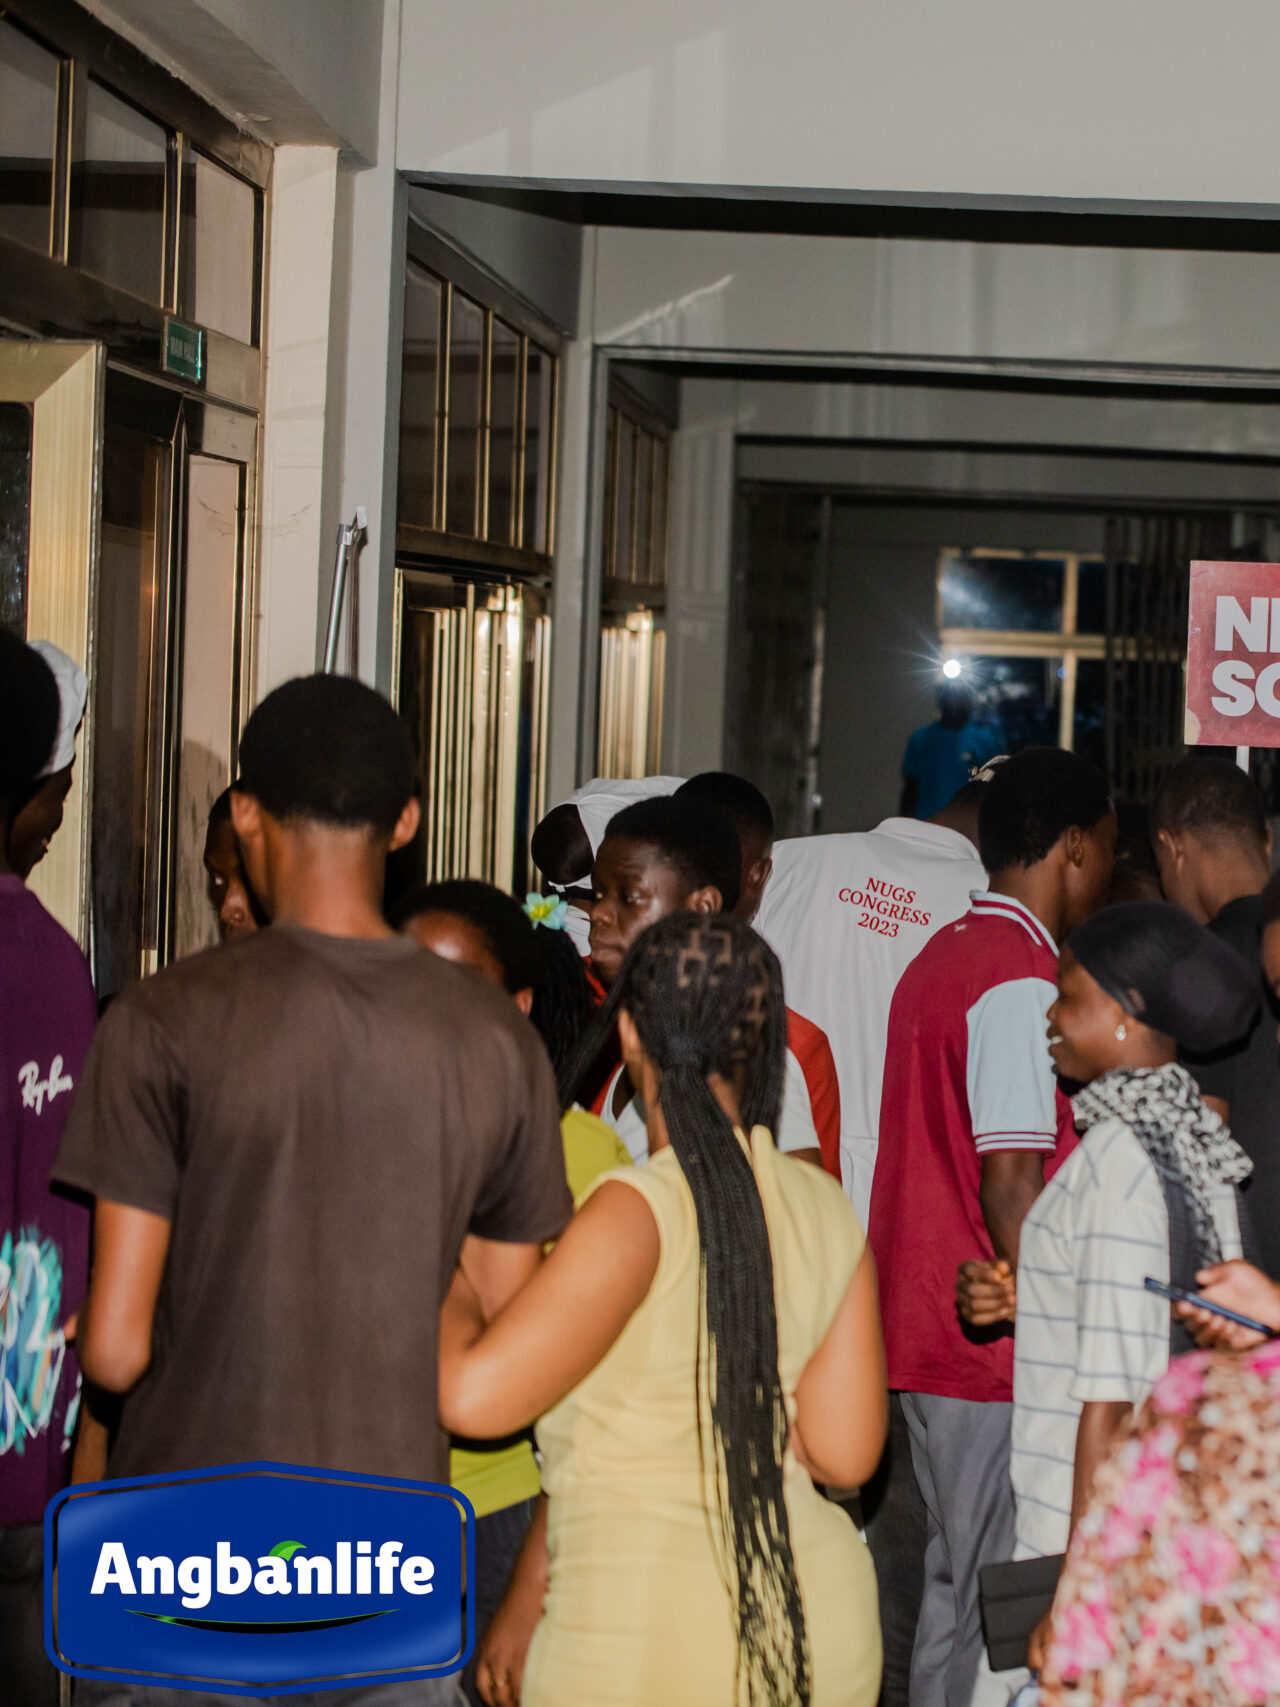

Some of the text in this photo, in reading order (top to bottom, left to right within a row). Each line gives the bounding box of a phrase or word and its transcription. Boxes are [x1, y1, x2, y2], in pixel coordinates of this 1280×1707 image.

[865, 876, 917, 905] NUGS
[838, 887, 932, 927] CONGRESS
[857, 911, 900, 938] 2023
